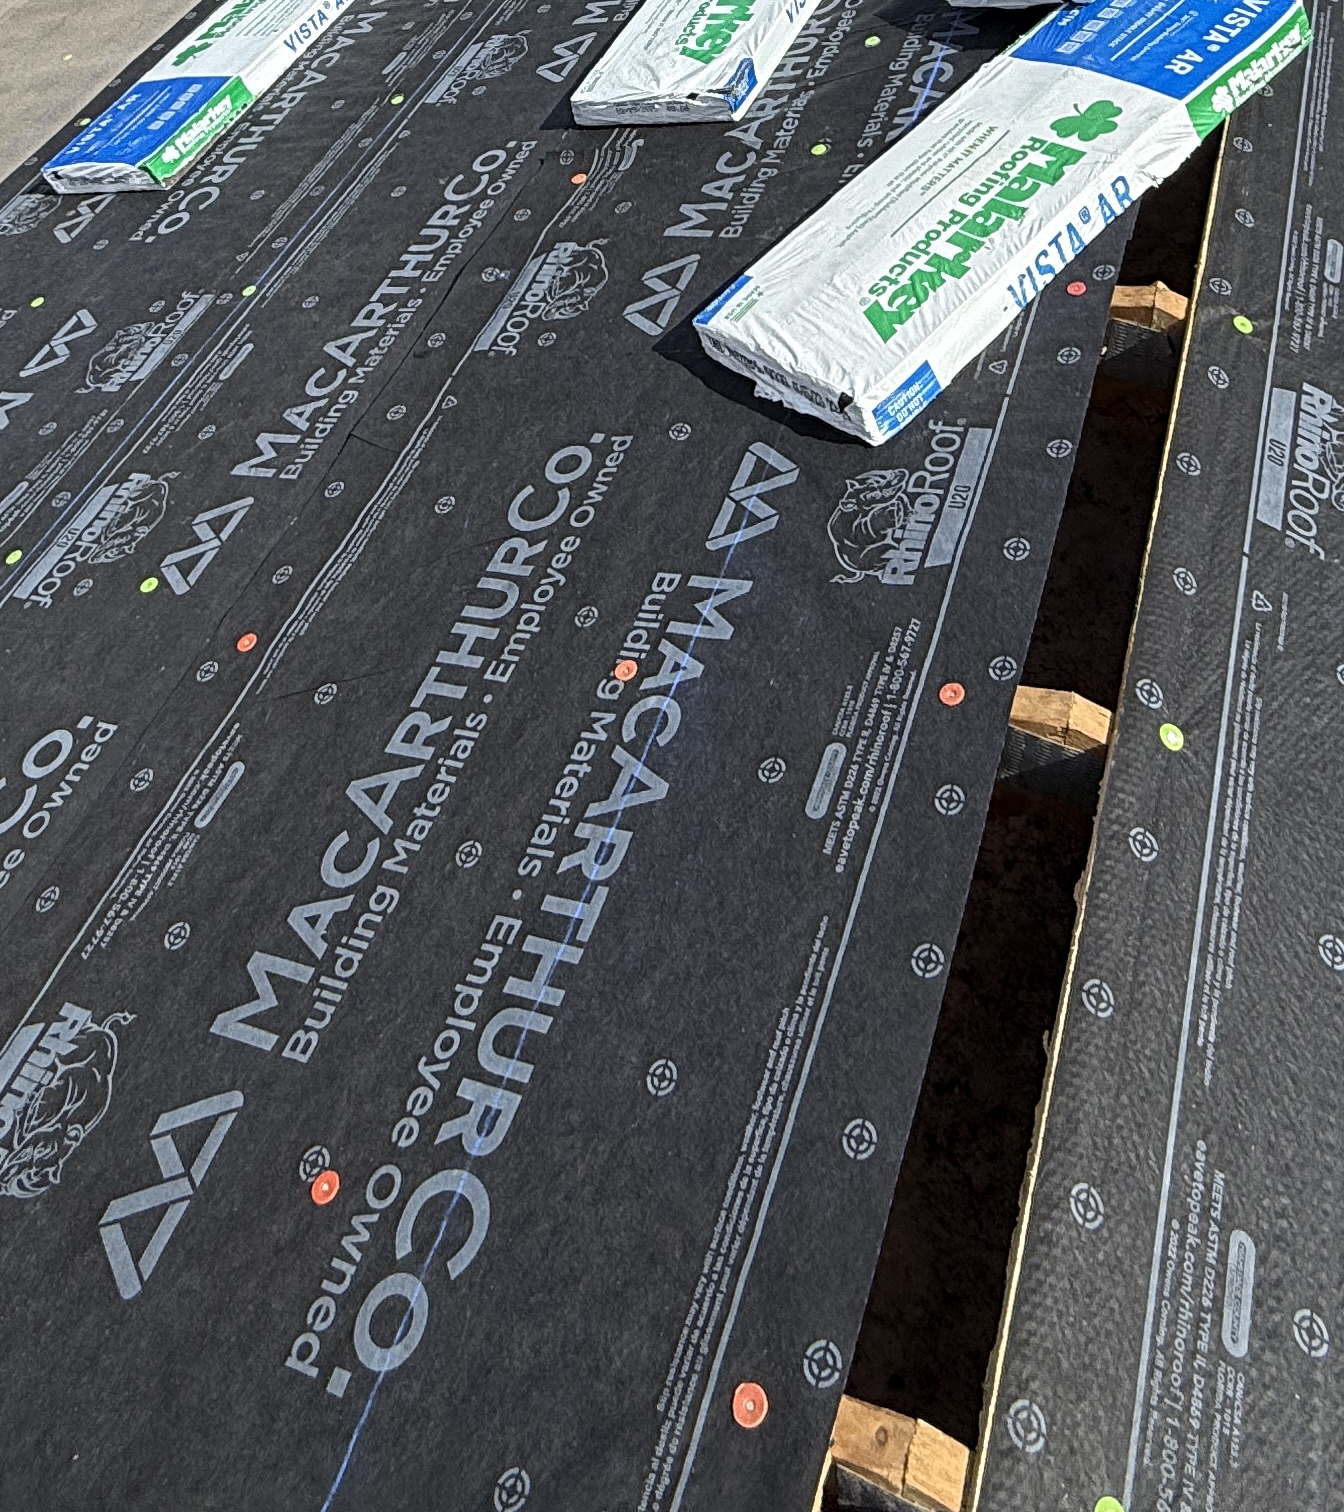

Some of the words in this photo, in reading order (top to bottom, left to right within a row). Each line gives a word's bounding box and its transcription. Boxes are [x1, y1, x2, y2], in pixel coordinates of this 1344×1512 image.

[720, 169, 769, 239] Building
[764, 87, 807, 166] Materials
[806, 15, 850, 80] Employee
[1164, 49, 1209, 78] AR
[958, 135, 1050, 208] Roofing
[1101, 175, 1134, 226] AR
[865, 138, 1087, 345] Malarkey
[872, 205, 962, 300] Products
[229, 139, 515, 480] MACARTHURCO.
[279, 389, 360, 481] Building
[352, 299, 424, 391] Materials
[421, 202, 486, 280] Employee
[480, 138, 538, 212] Owned
[882, 419, 967, 587] RhinoRoof
[946, 481, 972, 515] U20
[1270, 437, 1288, 469] U20
[1283, 382, 1334, 558] RhinoRoof
[36, 471, 152, 610] RhinoRoof
[21, 720, 119, 841] Owned
[209, 431, 606, 1052] MACARTHURCO.
[281, 885, 402, 1065] Building
[386, 709, 489, 877] Materials
[494, 522, 580, 684] Employee
[567, 432, 633, 532] Owned
[519, 693, 613, 880] Materials
[829, 709, 895, 873] eavetopeak.com/rhinoroof
[885, 617, 921, 702] 1-800-567-9727
[822, 819, 841, 854] MEETS
[833, 788, 851, 819] ASTM
[327, 574, 753, 1397] MACARTHURCO.
[390, 911, 521, 1151] Employee
[1198, 1218, 1224, 1265] ASTM
[1203, 1168, 1229, 1219] MEETS
[284, 1161, 403, 1378] Owned
[1170, 1140, 1208, 1397] eavetopeak.com/rhinoroof
[1190, 1310, 1215, 1354] TYPE
[1195, 1266, 1219, 1308] D226
[1181, 1373, 1210, 1428] D4869
[1211, 1359, 1228, 1409] FLORIDA
[1177, 1431, 1205, 1478] TYPE
